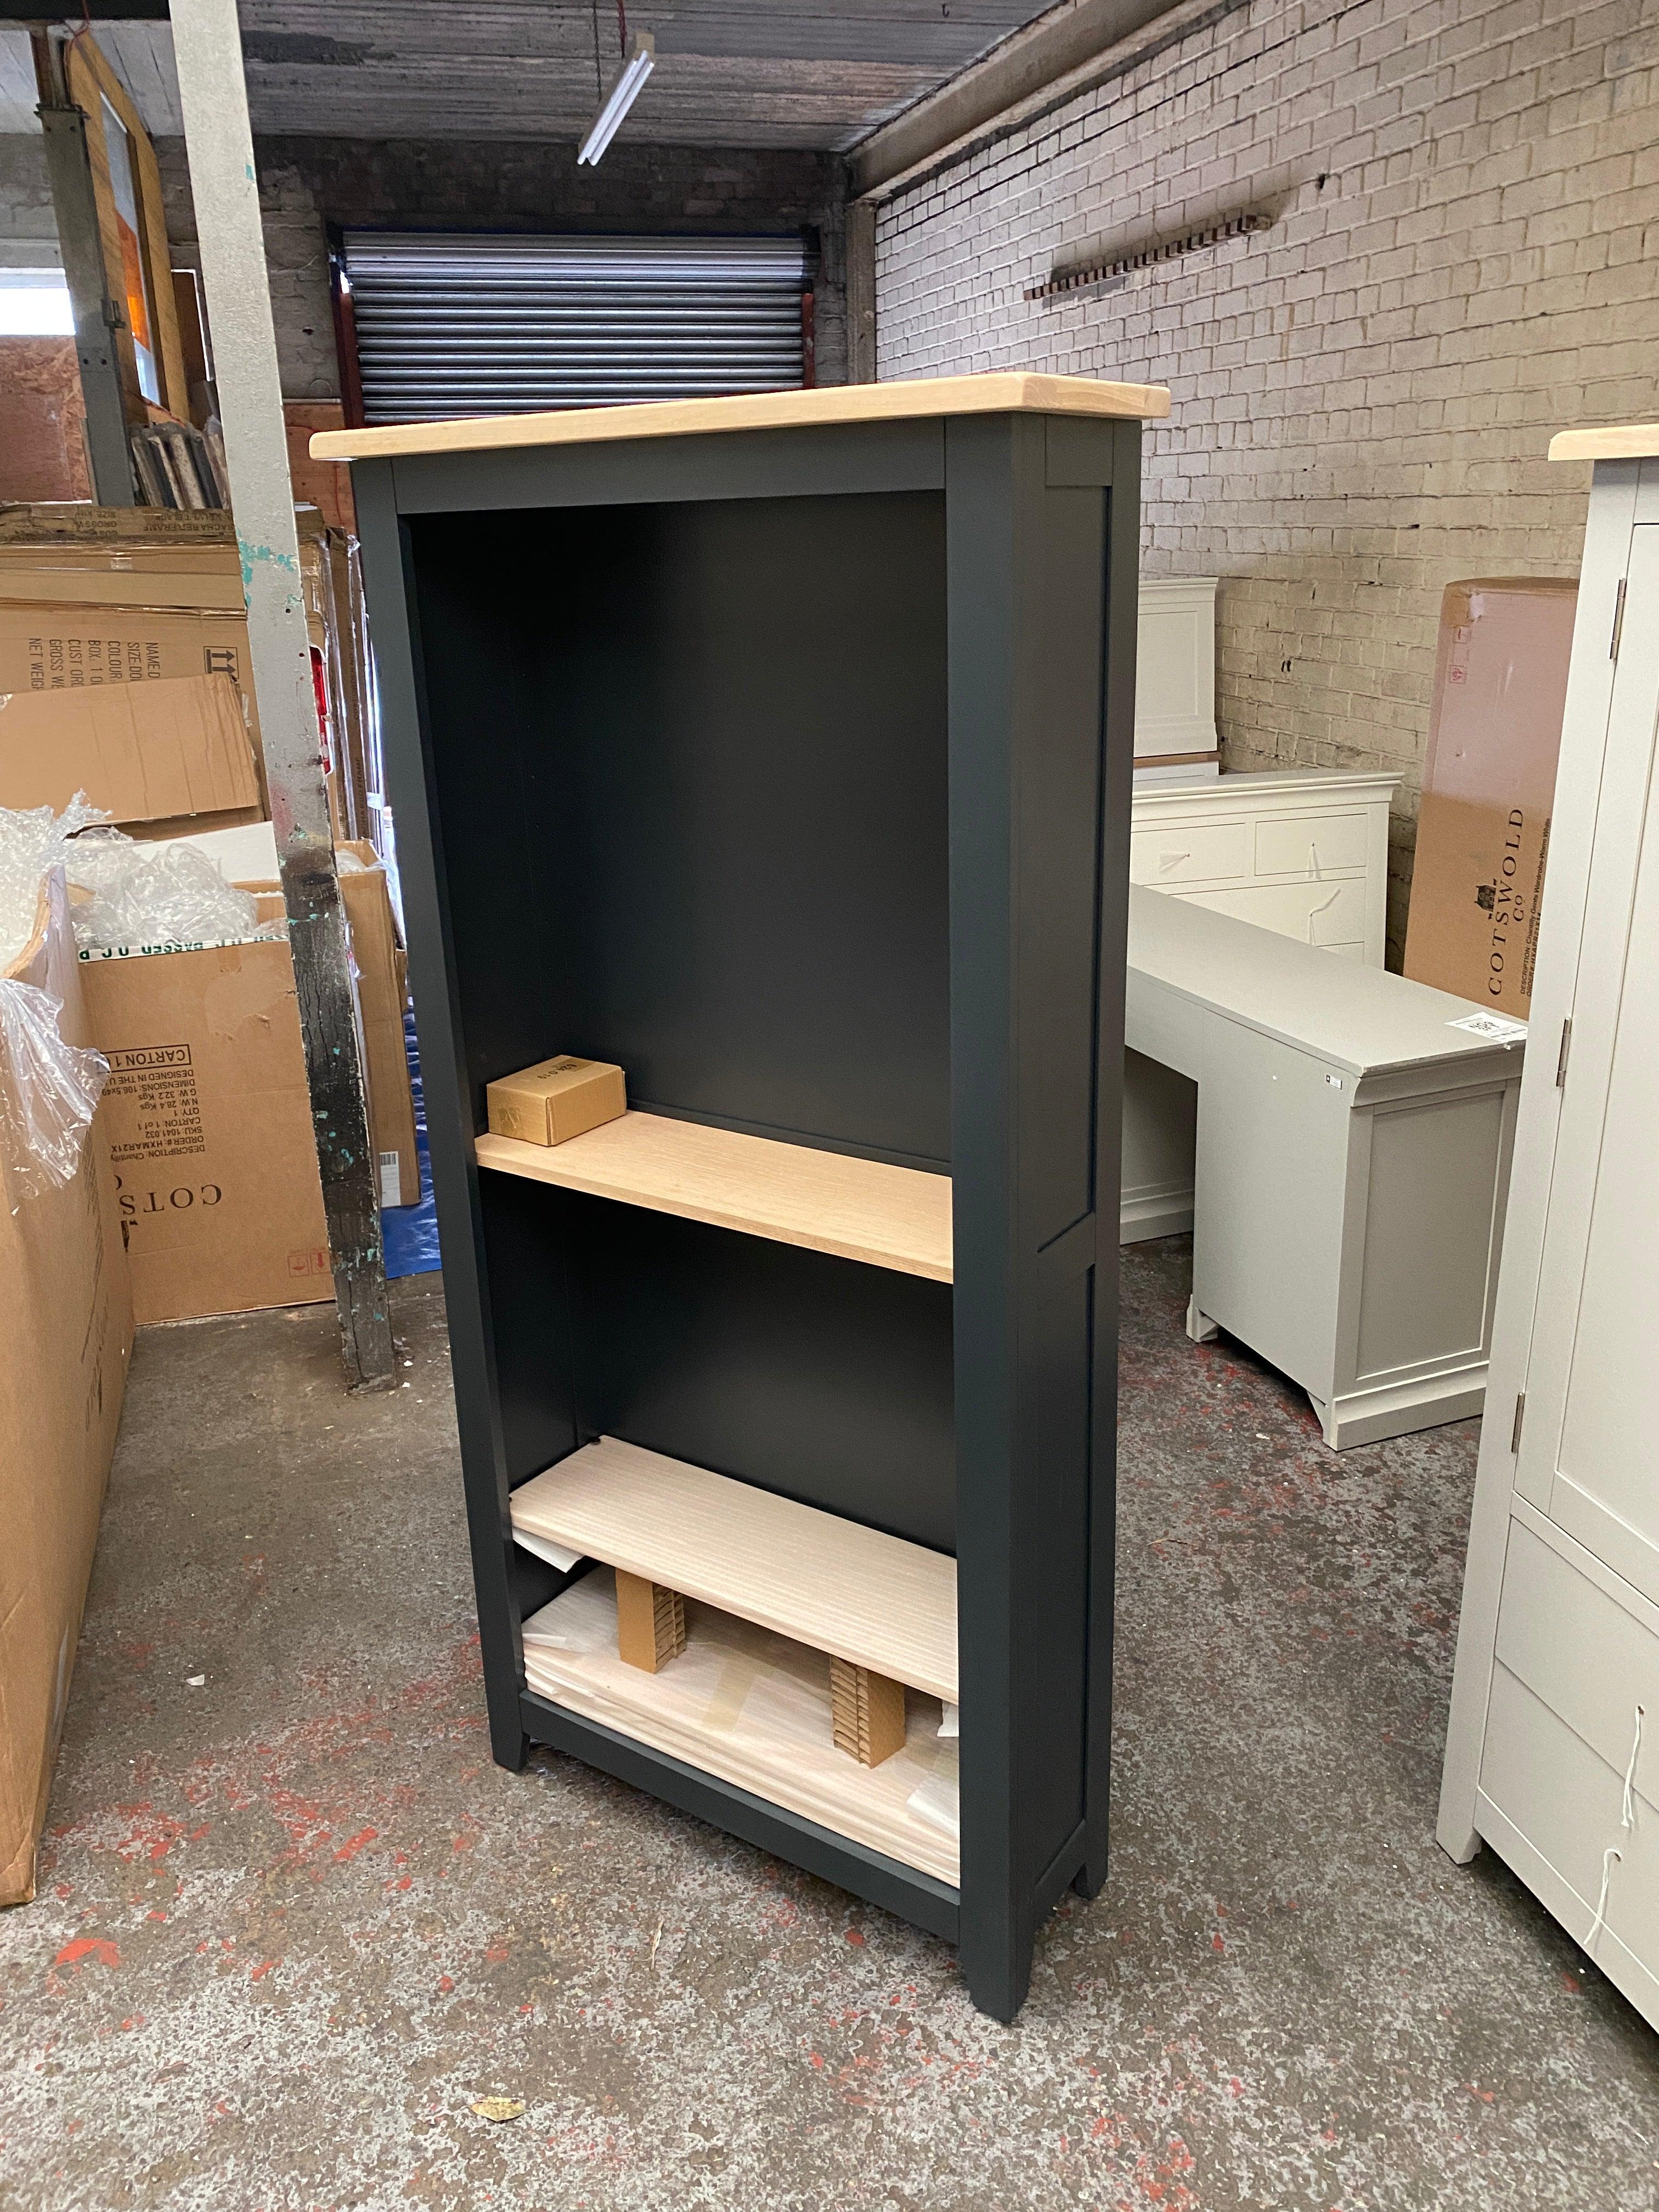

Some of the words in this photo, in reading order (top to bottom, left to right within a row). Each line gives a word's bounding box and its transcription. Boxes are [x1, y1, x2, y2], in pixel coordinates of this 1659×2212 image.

[29, 638, 43, 657] NET
[68, 640, 82, 665] CUST
[88, 641, 101, 661] BOX:
[49, 639, 64, 671] GROSS
[1488, 809, 1523, 996] COTSWOLD
[1530, 894, 1538, 914] Gents
[1526, 915, 1536, 944] Chantilly
[115, 1056, 121, 1067] 1
[126, 1049, 185, 1065] CARTON
[118, 1076, 136, 1084] THE
[148, 1069, 194, 1081] DESIGNED
[139, 1079, 195, 1092] DIMENSIONS:
[138, 1092, 154, 1102] Kgs
[140, 1102, 156, 1111] Kgs
[160, 1101, 176, 1109] 28.4
[180, 1107, 199, 1116] QTY:
[162, 1116, 201, 1127] CARTON:
[145, 1127, 180, 1138] 1041.032
[183, 1126, 202, 1135] SKU:
[110, 1151, 144, 1163] Chantilly
[145, 1144, 205, 1158] DESCRIPTION:
